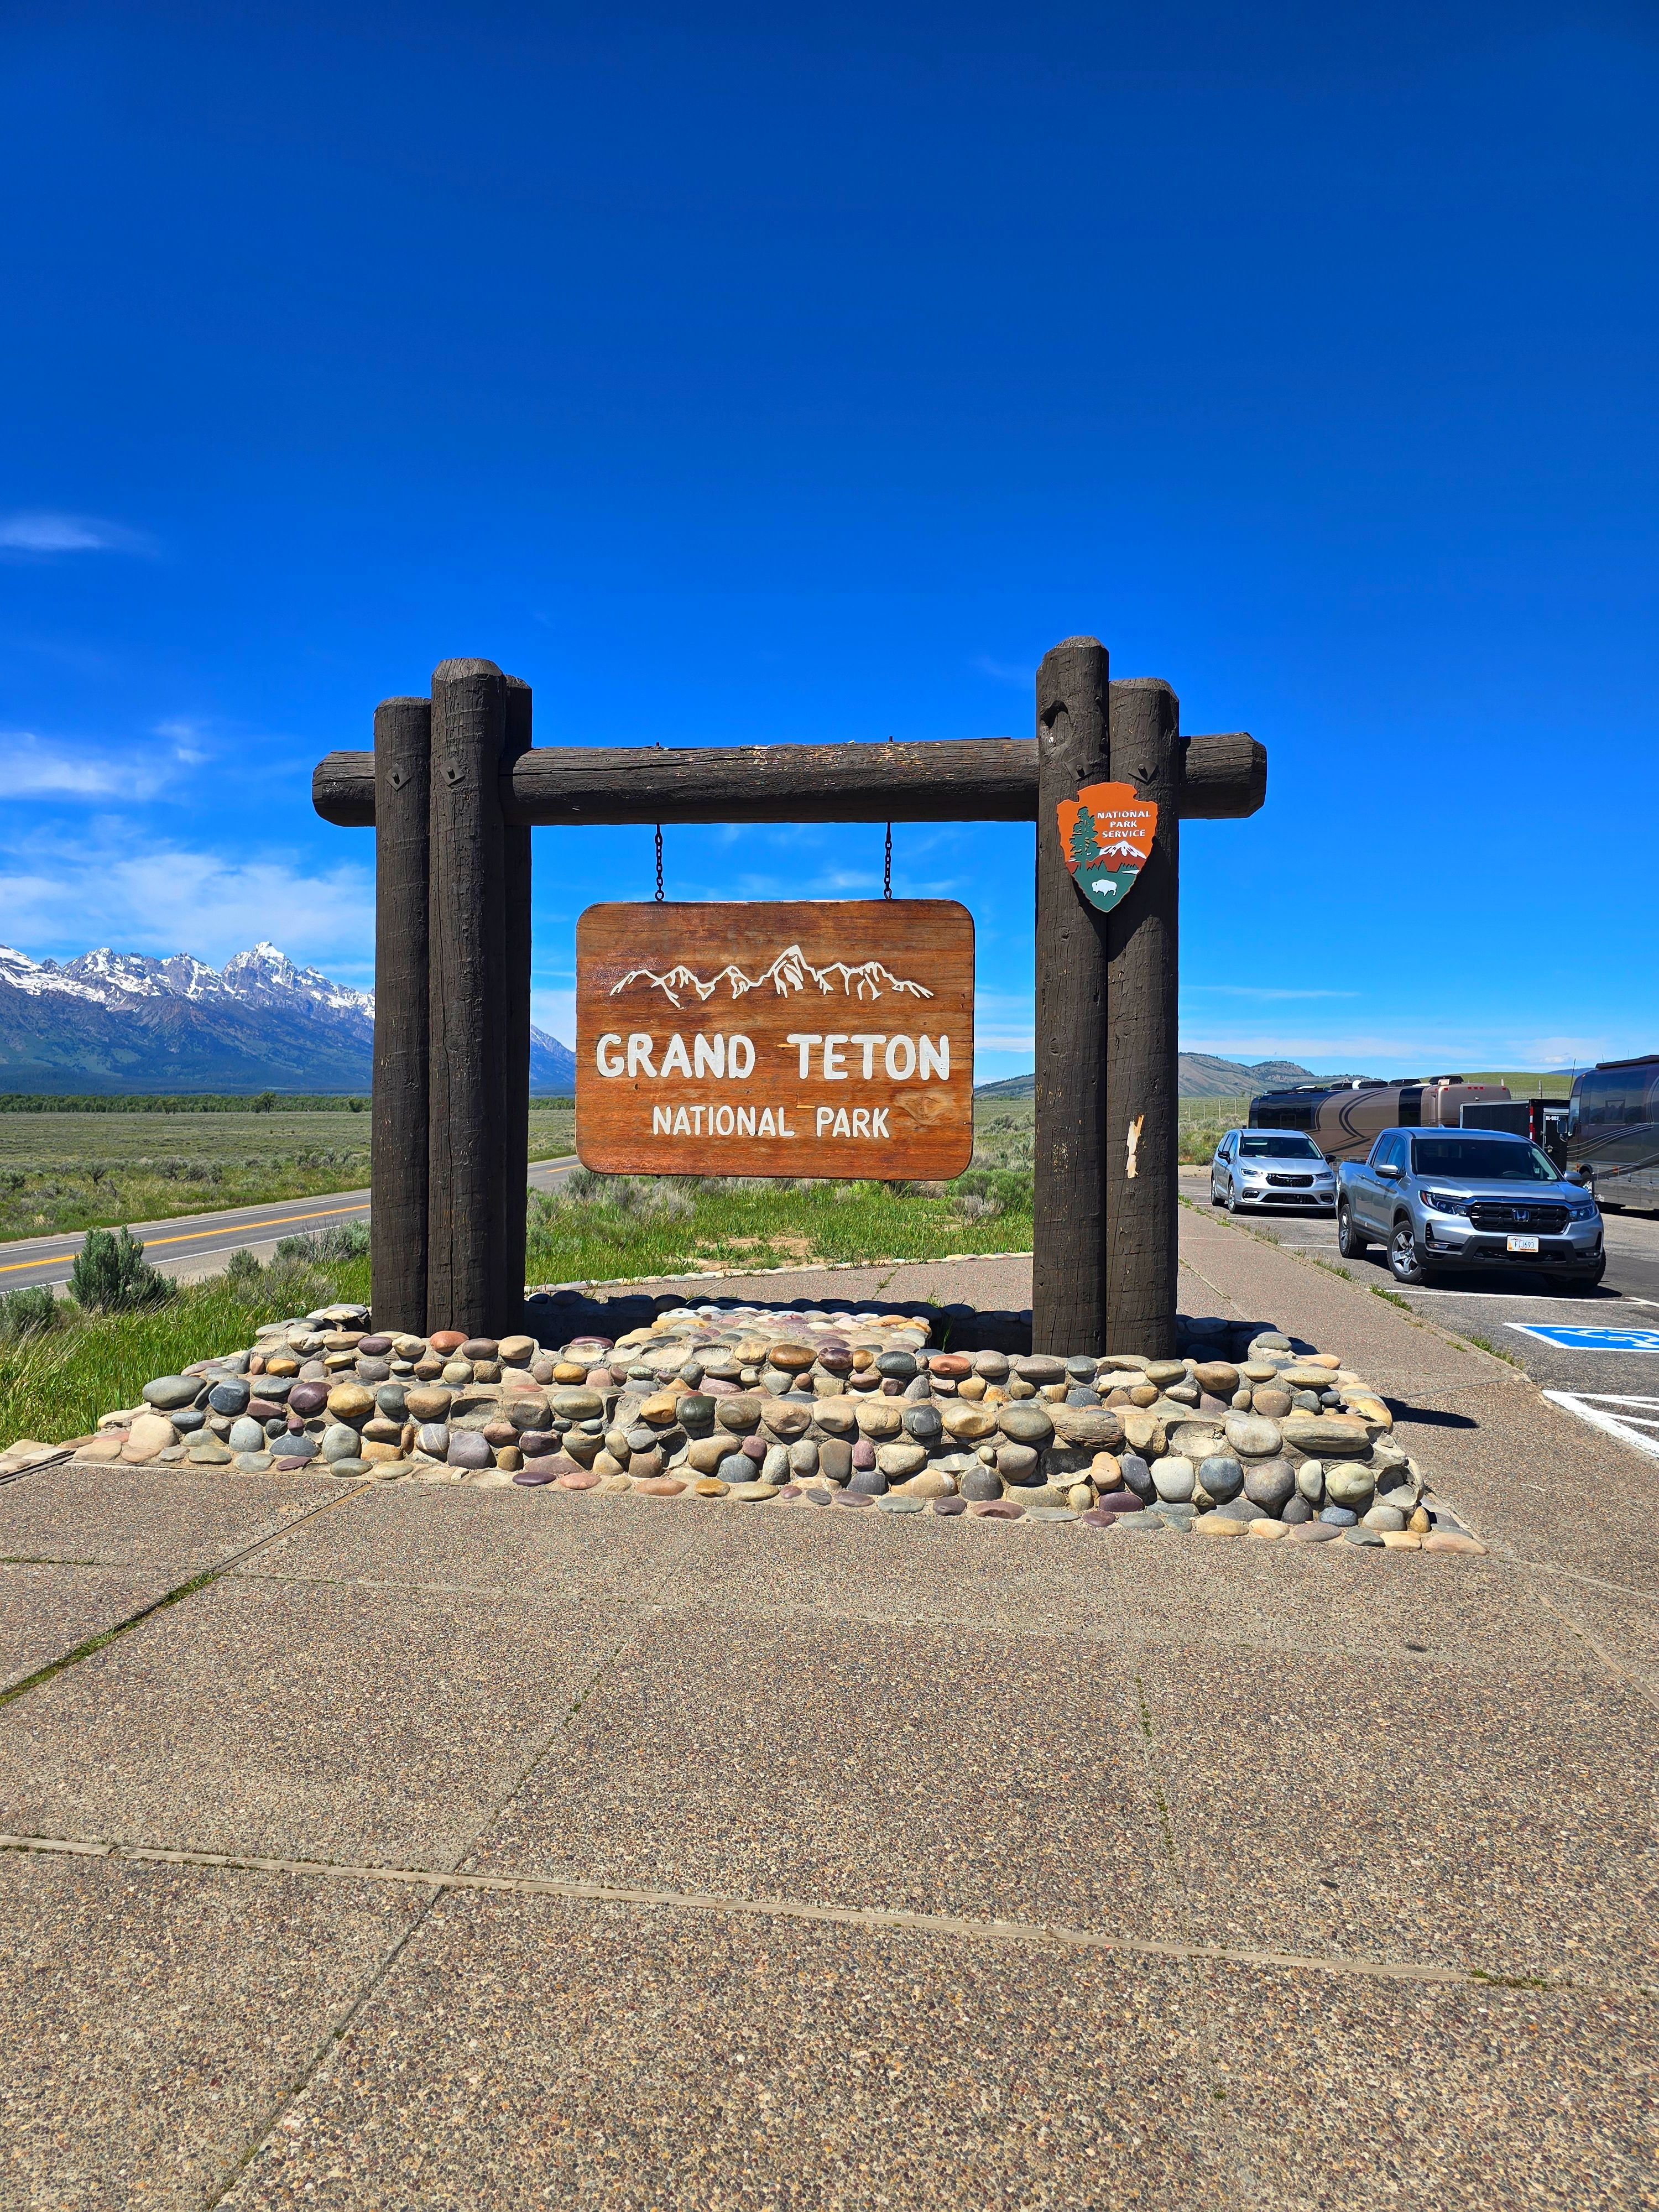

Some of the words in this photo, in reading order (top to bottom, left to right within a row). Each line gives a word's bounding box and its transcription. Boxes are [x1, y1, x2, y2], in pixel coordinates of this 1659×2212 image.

[1097, 810, 1151, 819] NATIONAL
[1110, 820, 1138, 828] PARK
[1102, 829, 1146, 838] SERVICE
[596, 1032, 755, 1079] GRAND
[786, 1034, 950, 1081] TETON
[653, 1105, 795, 1137] NATIONAL
[816, 1107, 890, 1138] PARK
